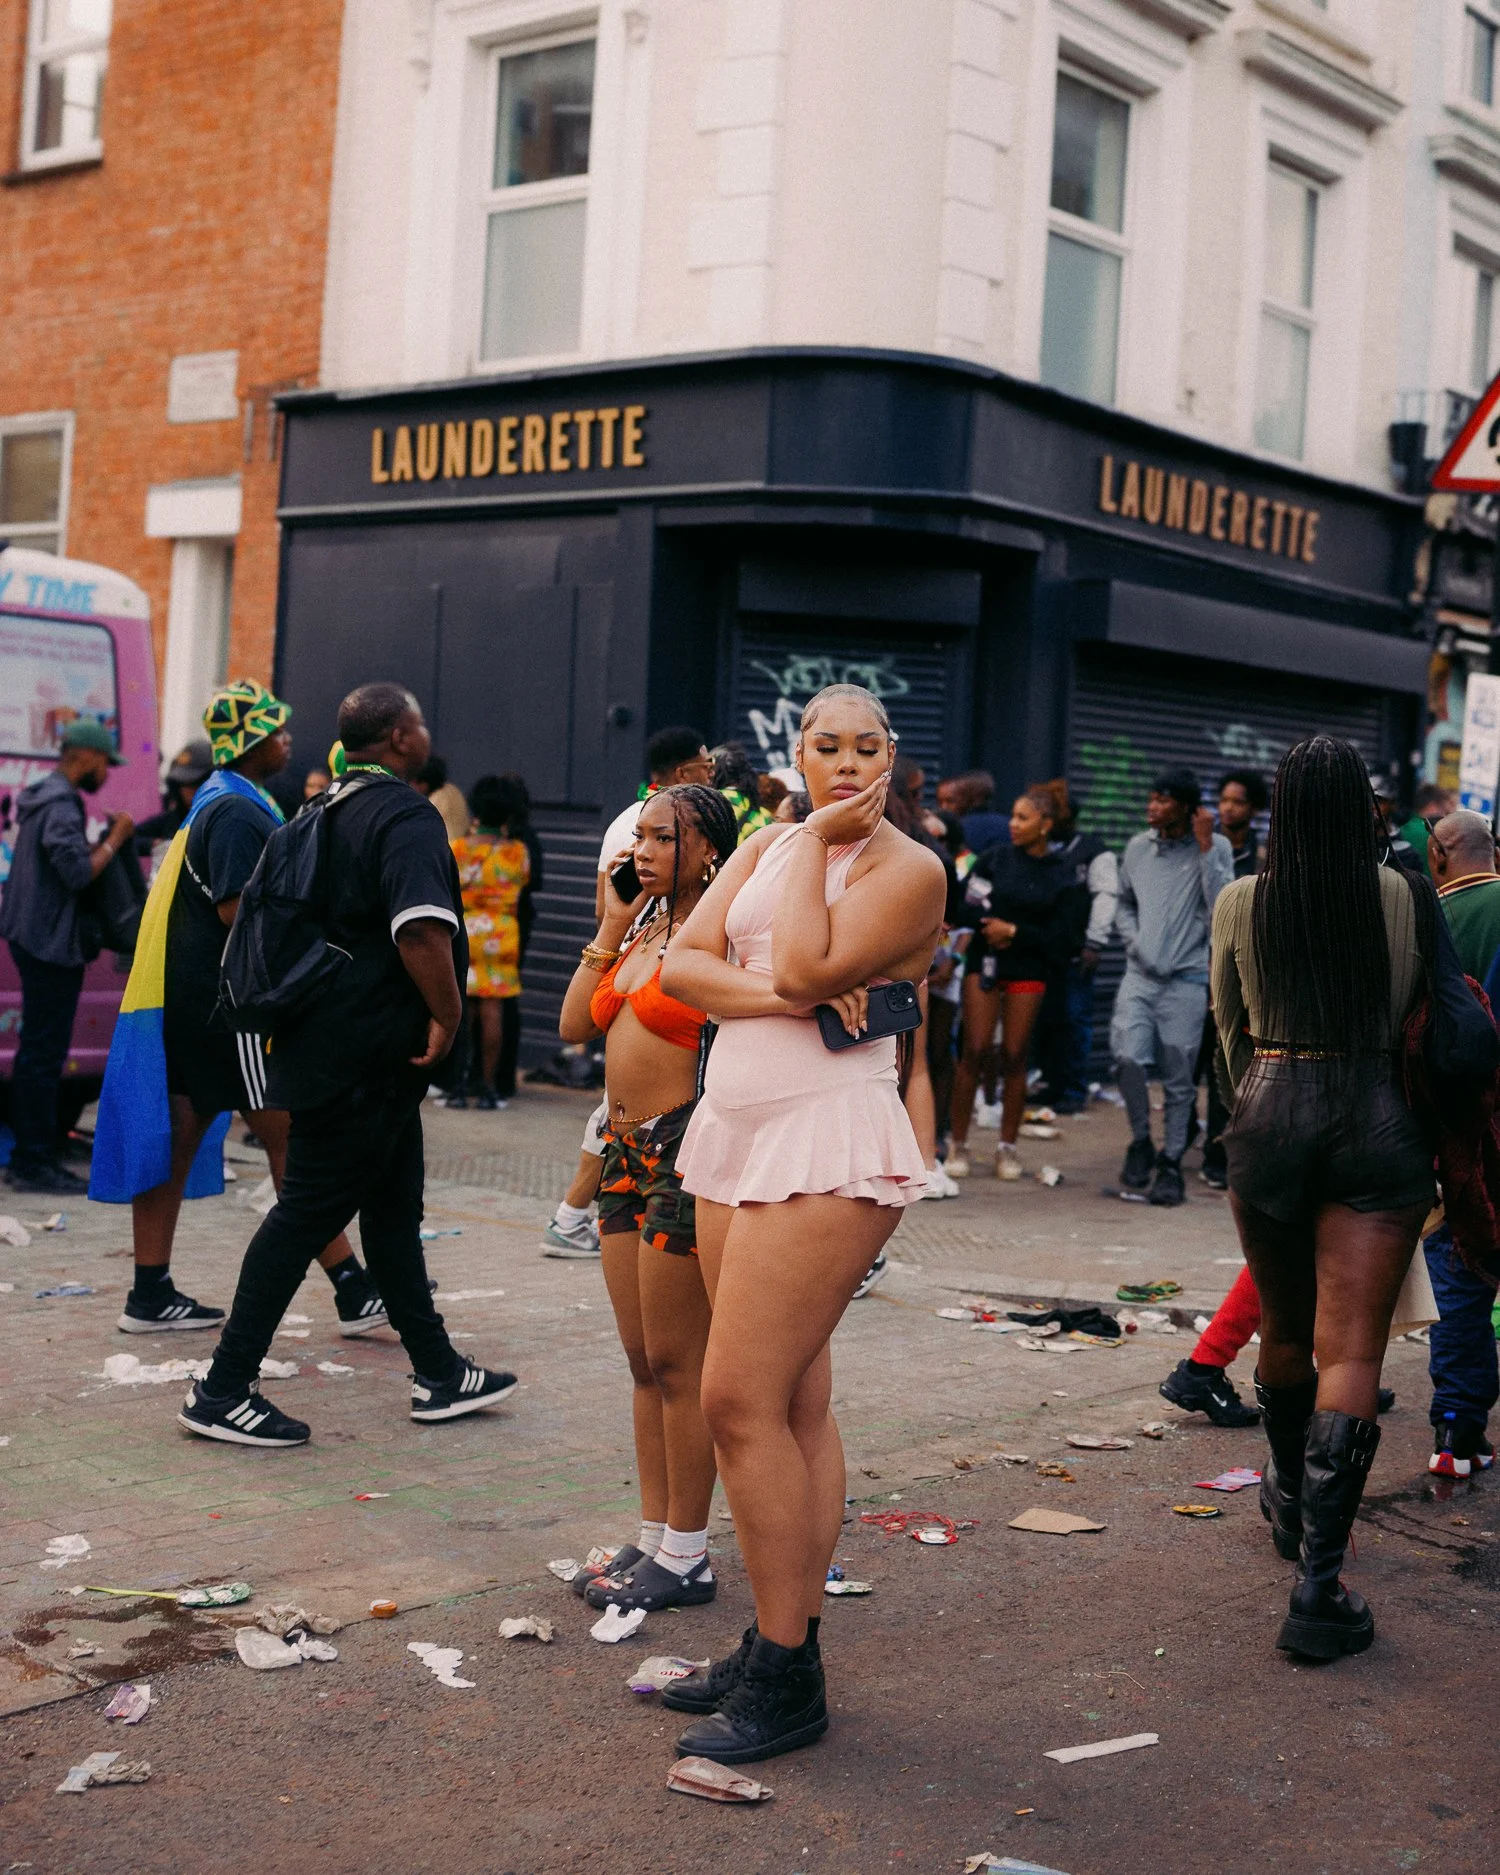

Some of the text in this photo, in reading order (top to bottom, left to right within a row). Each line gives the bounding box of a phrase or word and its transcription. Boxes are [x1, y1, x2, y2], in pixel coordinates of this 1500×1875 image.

[371, 405, 645, 484] LAUNDERETTE
[1100, 454, 1321, 563] LAUNDERETTE
[25, 574, 97, 615] TIME
